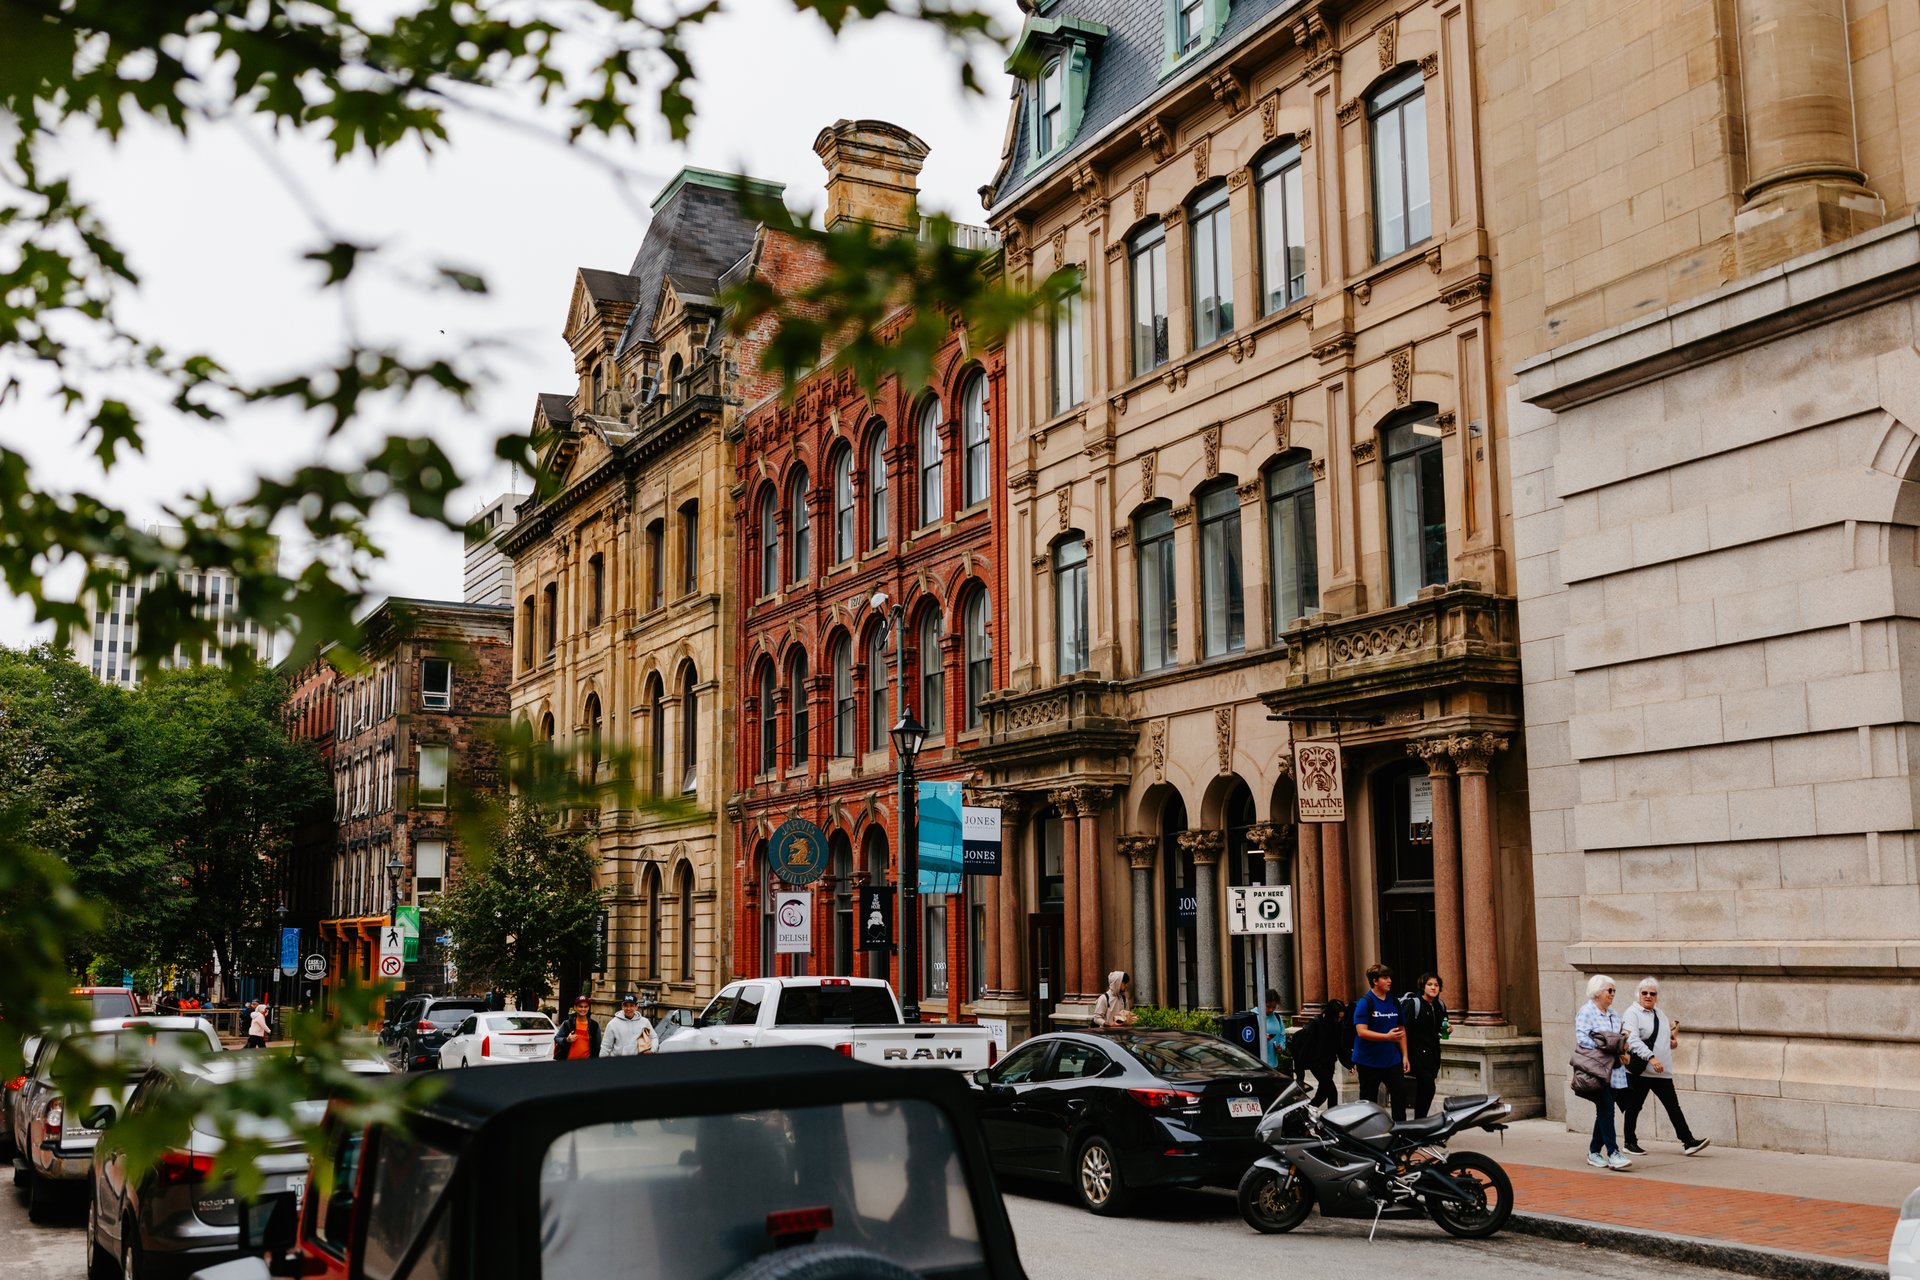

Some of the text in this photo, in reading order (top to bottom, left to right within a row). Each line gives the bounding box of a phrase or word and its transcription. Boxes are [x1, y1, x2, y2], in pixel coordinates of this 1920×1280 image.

[1300, 798, 1343, 808] PALATINE
[965, 816, 996, 826] JONES
[781, 819, 816, 836] JARVIS
[964, 850, 996, 860] JONES
[776, 865, 822, 884] BUILDING
[1263, 901, 1277, 919] P
[596, 915, 604, 932] Fine
[779, 934, 809, 942] DELISH
[1372, 1010, 1398, 1019] Champion
[985, 1024, 1004, 1036] NES
[884, 1047, 962, 1060] RAM
[1232, 1103, 1260, 1113] JGY 042
